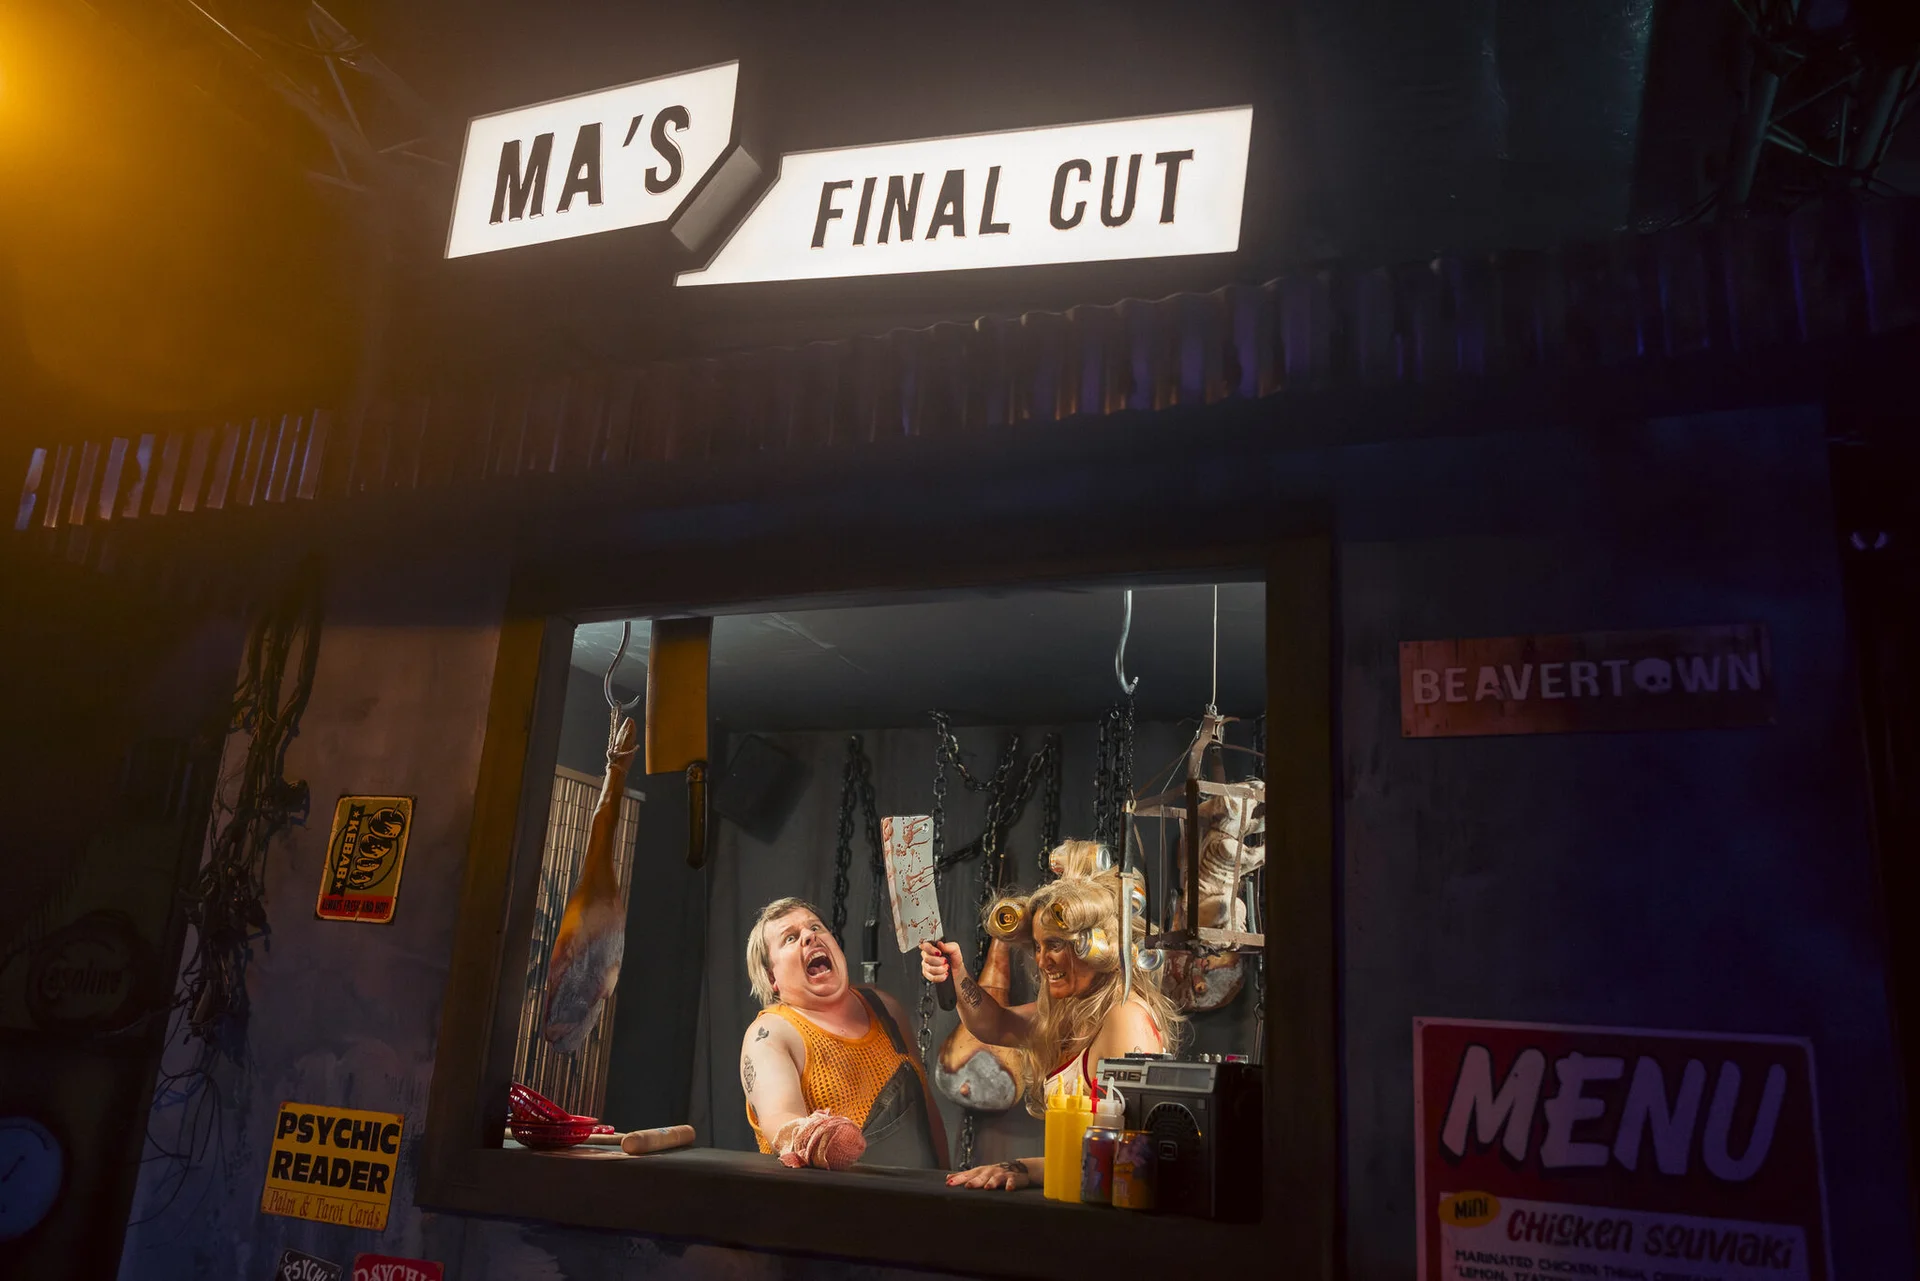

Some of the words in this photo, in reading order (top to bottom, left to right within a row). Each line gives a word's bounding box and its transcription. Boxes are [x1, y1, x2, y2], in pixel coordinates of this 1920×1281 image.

[489, 105, 691, 225] MA'S
[811, 166, 1010, 250] FINAL
[1049, 149, 1194, 231] CUT
[337, 820, 360, 880] KEBAB
[277, 1111, 400, 1154] PSYCHIC
[1441, 1044, 1787, 1183] MENU
[272, 1150, 389, 1194] READER
[268, 1190, 296, 1212] Palm
[300, 1196, 311, 1217] &
[316, 1198, 345, 1221] Tarot
[1455, 1249, 1534, 1268] MARINATED
